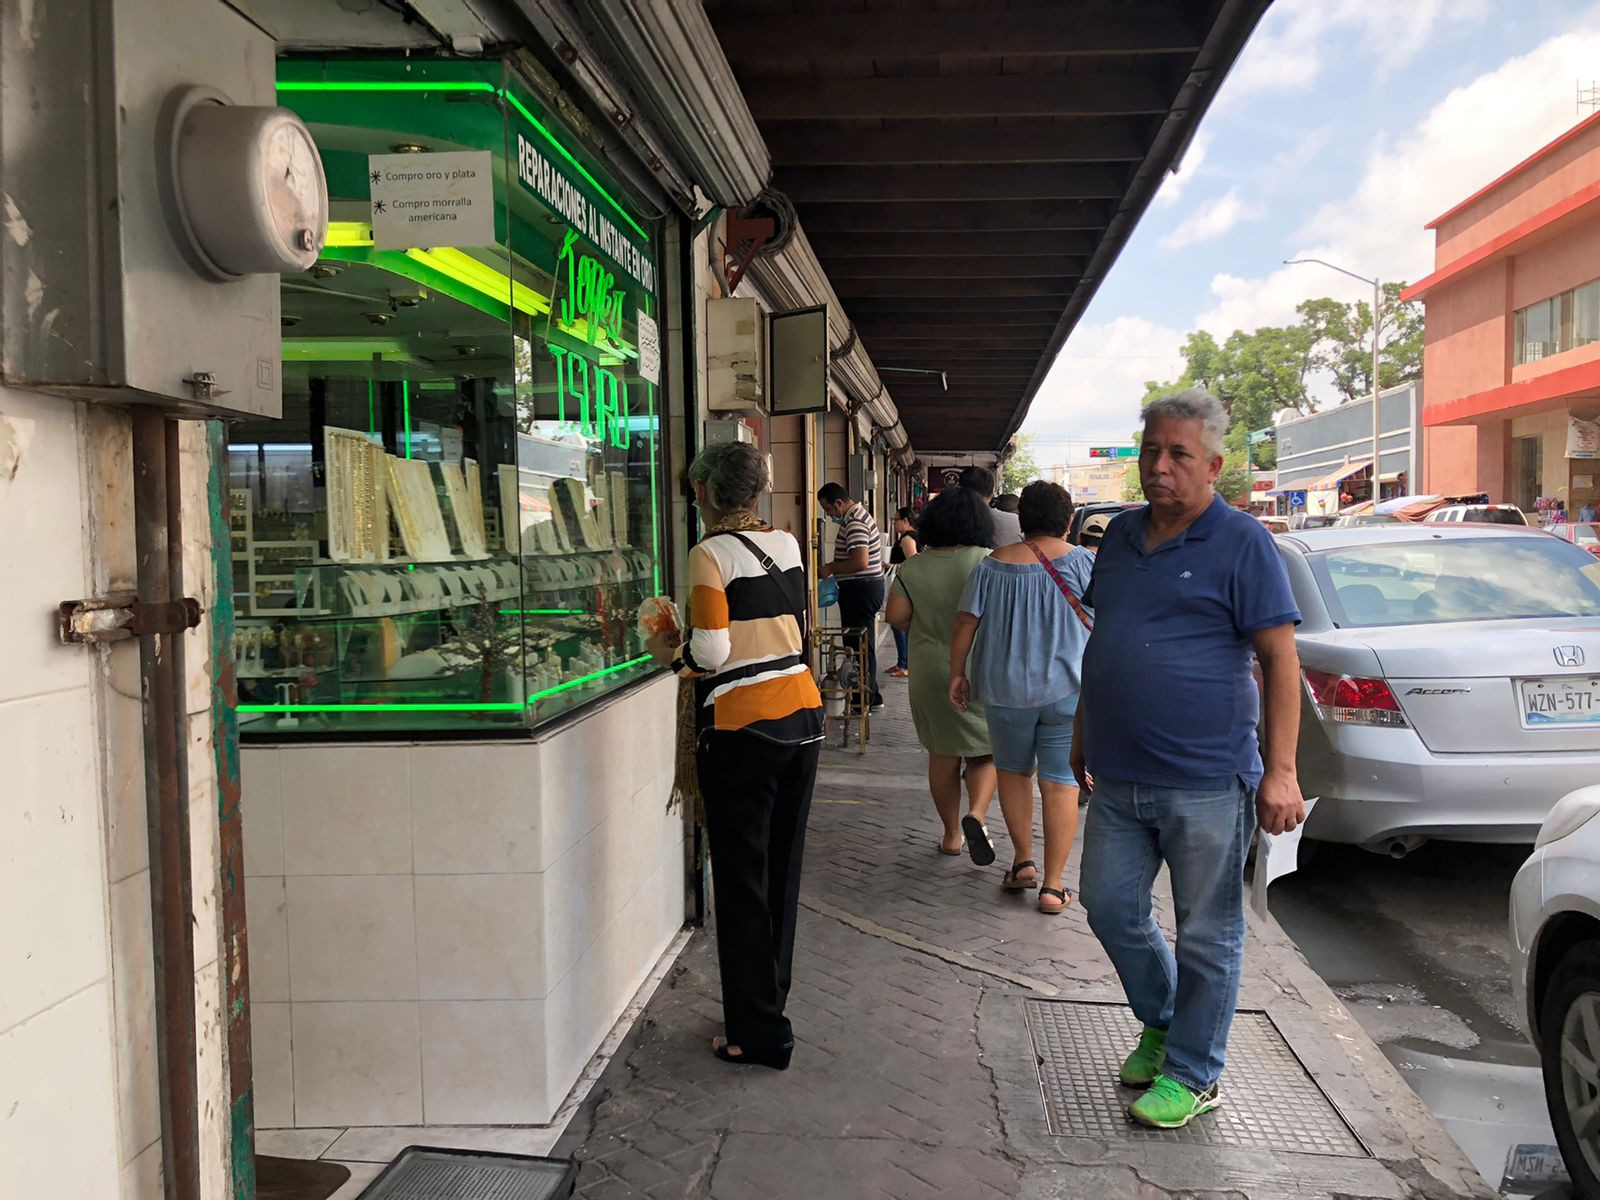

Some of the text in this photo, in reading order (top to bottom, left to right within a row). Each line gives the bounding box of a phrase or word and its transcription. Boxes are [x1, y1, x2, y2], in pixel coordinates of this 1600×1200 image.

[385, 169, 476, 182] Compro oro y plata
[392, 197, 472, 210] Compro morralla
[408, 213, 458, 222] americana
[518, 133, 654, 293] REPARACIONES AL INSTANTE EN ORO
